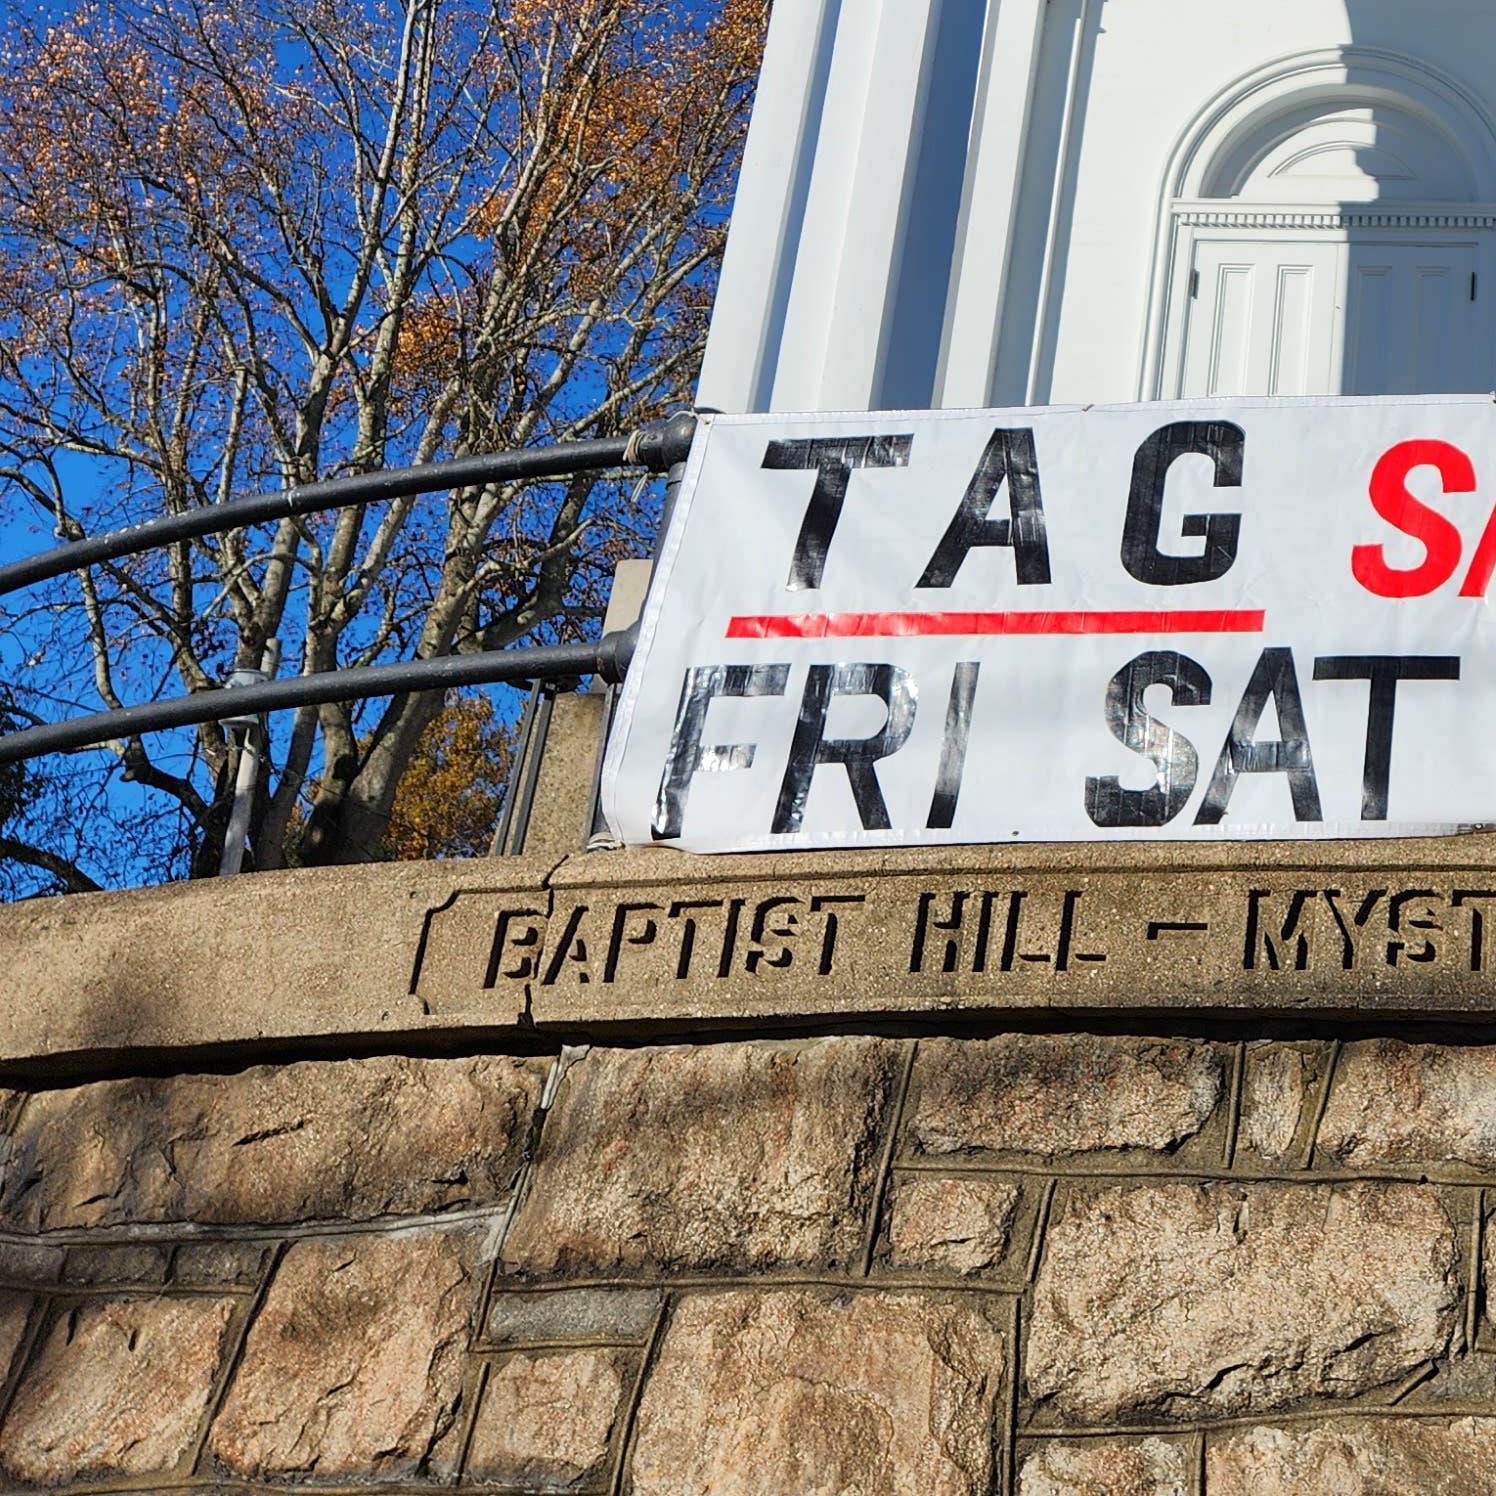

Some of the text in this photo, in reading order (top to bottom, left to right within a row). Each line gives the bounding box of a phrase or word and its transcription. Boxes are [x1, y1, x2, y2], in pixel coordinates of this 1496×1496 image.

[760, 419, 1246, 592] TAG
[650, 661, 982, 842] FRI
[1084, 645, 1461, 829] SAT
[481, 896, 869, 989] BAPTIST
[908, 889, 1107, 974] HILL
